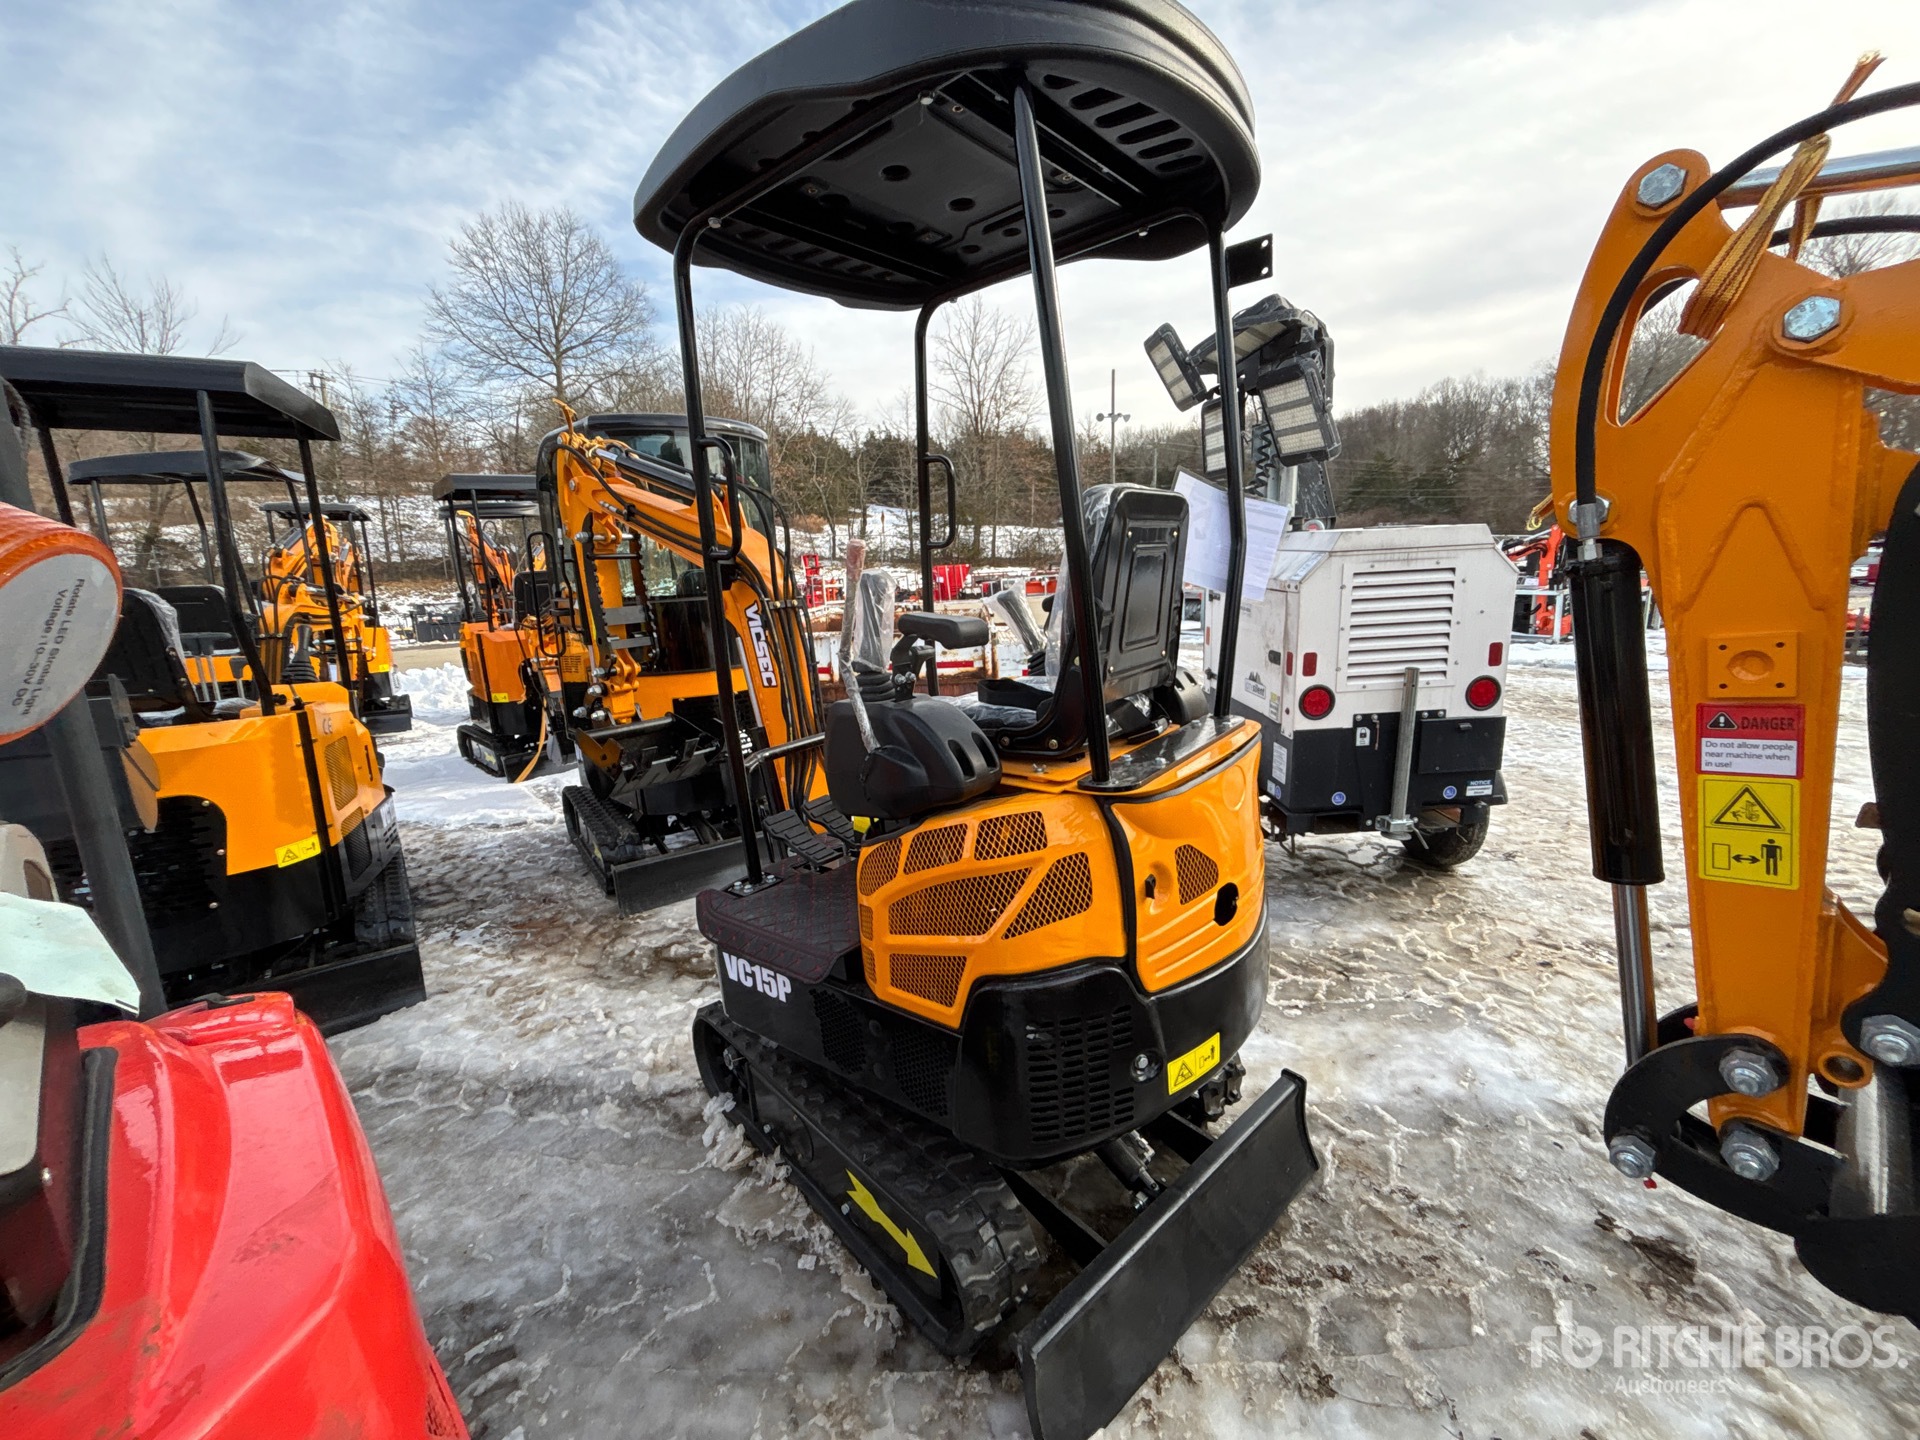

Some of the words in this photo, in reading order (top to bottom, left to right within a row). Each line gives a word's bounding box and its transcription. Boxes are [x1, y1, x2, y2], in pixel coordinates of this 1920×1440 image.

[65, 578, 85, 616] Rotate
[54, 620, 70, 644] LED
[746, 601, 777, 687] VICSEC
[37, 647, 60, 684] Strobe
[12, 688, 28, 706] DC
[21, 688, 42, 715] Light
[1741, 716, 1795, 731] DANGER
[1726, 751, 1763, 760] machine
[1765, 753, 1790, 761] when
[1737, 741, 1760, 750] allow
[1762, 743, 1794, 752] people
[1705, 760, 1713, 768] in
[722, 951, 792, 1003] VC15P
